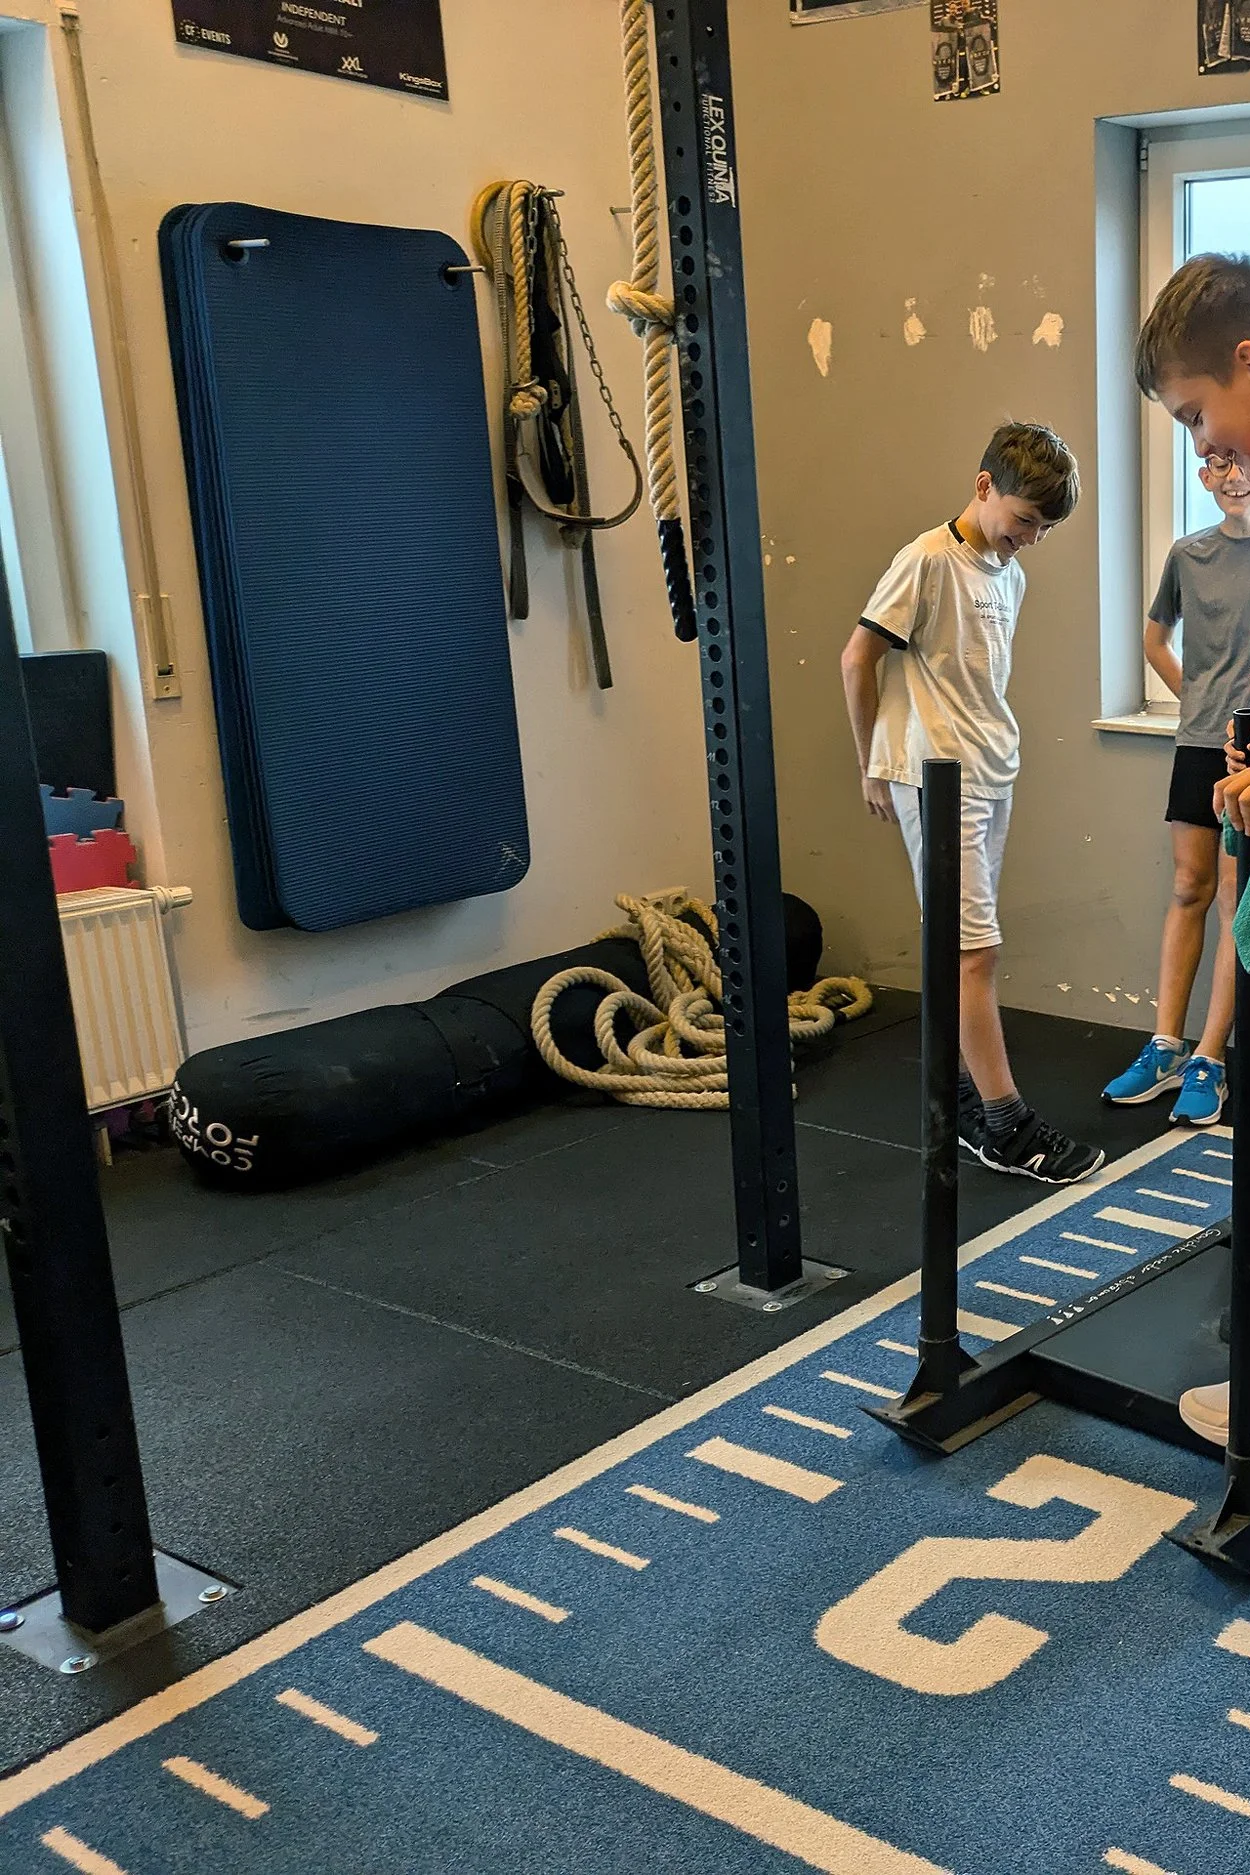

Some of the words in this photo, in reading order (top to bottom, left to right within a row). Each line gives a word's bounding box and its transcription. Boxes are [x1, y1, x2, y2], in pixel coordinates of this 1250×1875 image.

[281, 2, 347, 26] INDEPENDENT
[201, 28, 232, 45] EVENTS
[341, 56, 364, 71] XXL
[814, 1454, 1197, 1696] 2
